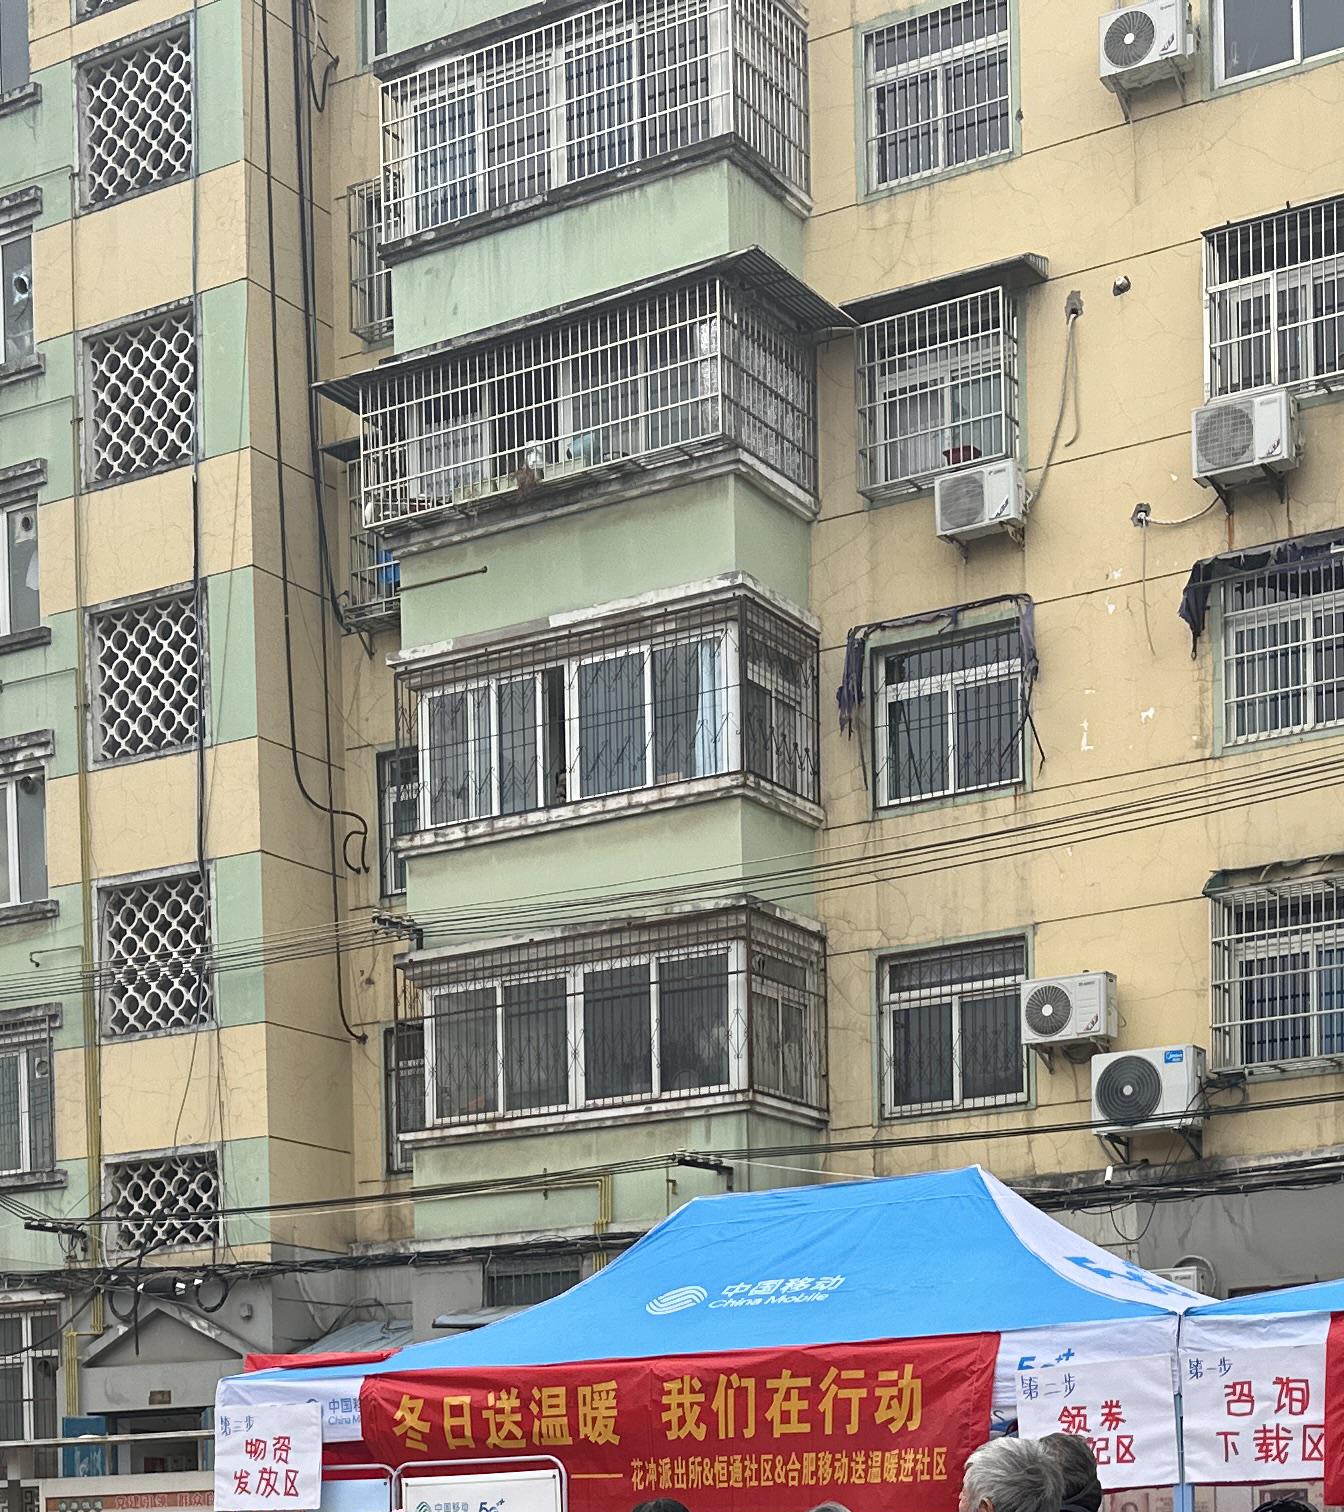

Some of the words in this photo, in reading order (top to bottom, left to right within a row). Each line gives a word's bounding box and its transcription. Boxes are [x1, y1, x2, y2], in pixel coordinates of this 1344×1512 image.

[708, 1297, 763, 1309] China
[765, 1292, 830, 1305] Mobile
[721, 1274, 846, 1298] 中国移动
[392, 1380, 621, 1451] 冬日送温暖
[661, 1363, 924, 1442] 我们在行动
[1224, 1376, 1310, 1417] 咨询
[1087, 1434, 1137, 1465] 记区
[1216, 1423, 1325, 1465] 下载区
[233, 1466, 300, 1498] 发放区
[434, 1502, 469, 1512] 中国移动
